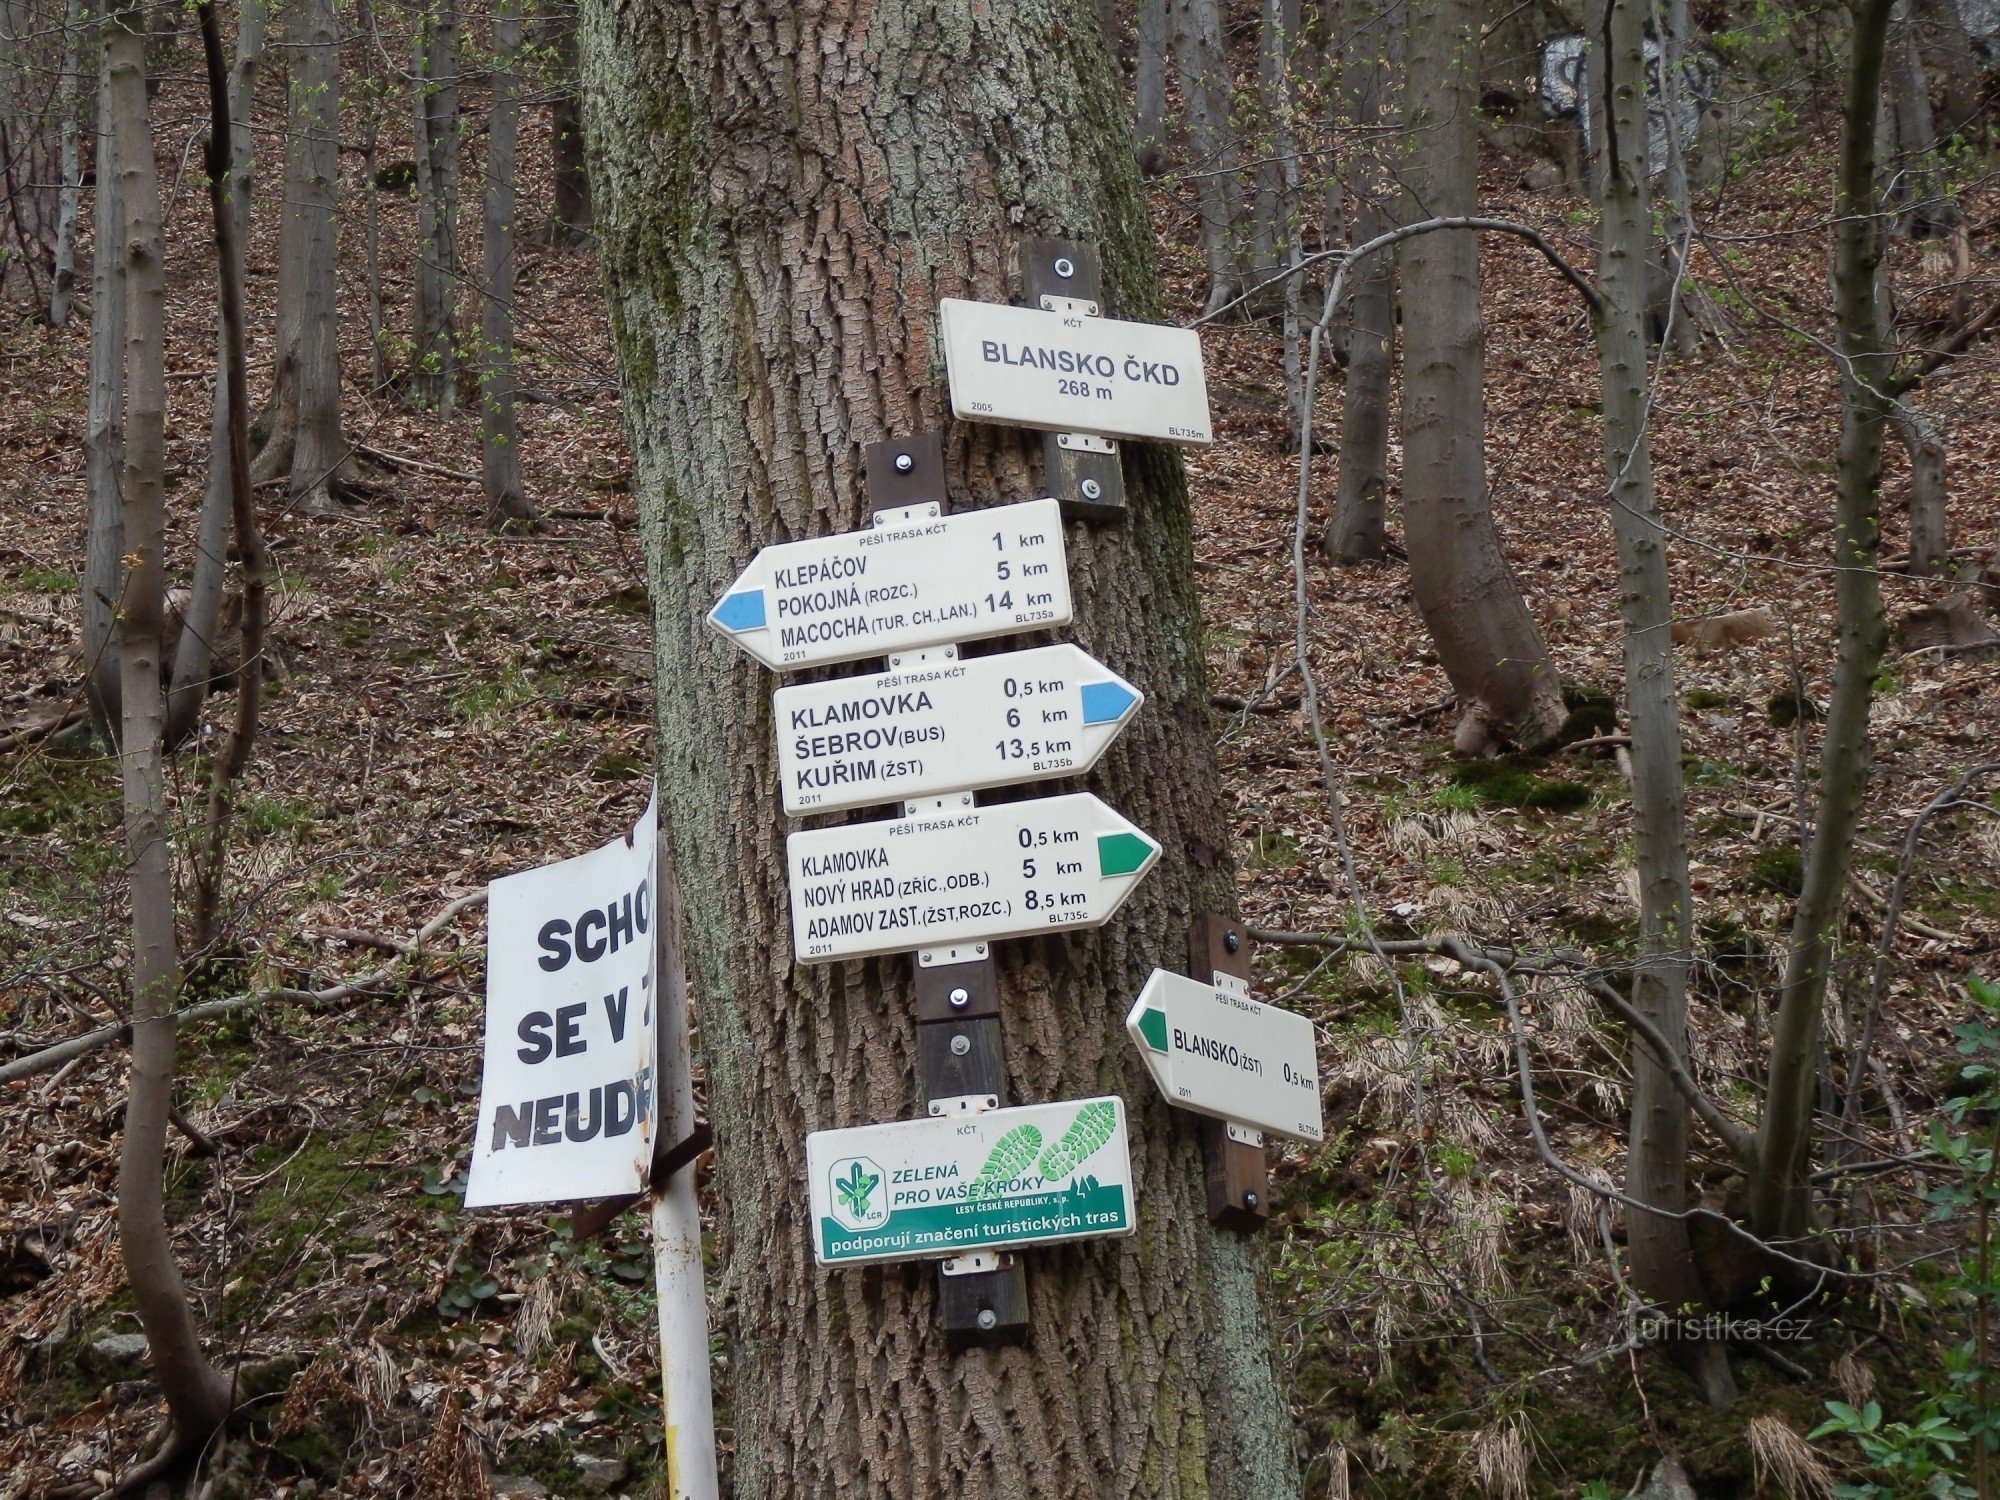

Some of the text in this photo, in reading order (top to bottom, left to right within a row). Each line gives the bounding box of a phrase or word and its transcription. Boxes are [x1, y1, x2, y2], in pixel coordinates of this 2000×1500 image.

[1063, 318, 1082, 329] KČT
[982, 341, 1180, 386] BLANSKO ČKD
[1058, 379, 1113, 400] 268 m
[971, 402, 993, 413] 2005
[1169, 427, 1204, 440] BL735m
[859, 523, 947, 547] PĚŠÍ TRASA KČT
[775, 532, 1045, 589] KLEPÁČOV 1 km
[778, 560, 1048, 618] POKOJNÁ (ROZC.) 5 km
[781, 615, 869, 648] MACOCHA
[984, 590, 1014, 614] 14
[1027, 591, 1052, 607] km
[1015, 611, 1054, 624] BL735a
[783, 650, 806, 661] 2011
[877, 667, 967, 689] PĚŠÍ TRASA KČT
[791, 677, 1064, 730] KLAMOVKA 0,5 km
[1006, 708, 1020, 729] 6
[1043, 708, 1068, 723] km
[797, 738, 1071, 790] KUŘIM (ŽST) 13,5 km
[1033, 757, 1073, 771] BL735b
[799, 794, 822, 805] 2011
[889, 815, 980, 837] PĚŠÍ TRASA KČT
[801, 828, 1079, 878] KLAMOVKA 0,5 km
[804, 878, 846, 908] NOVÝ
[851, 877, 894, 902] HRAD
[1022, 858, 1036, 878] 5
[1056, 861, 1082, 875] km
[807, 911, 874, 940] ADAMOV
[1025, 890, 1054, 911] 8,5
[1060, 892, 1086, 906] km
[1049, 911, 1088, 923] BL735c
[809, 944, 832, 955] 2011
[1229, 998, 1249, 1013] TRASA
[517, 1001, 587, 1065] SE
[603, 985, 629, 1044] V
[1283, 1062, 1298, 1087] 0,5
[1301, 1074, 1314, 1091] km
[1179, 1086, 1192, 1099] 2011
[956, 1124, 977, 1136] KČT
[892, 1161, 959, 1184] ZELENÁ
[894, 1176, 1045, 1205] PRO VAŠE KROKY
[955, 1204, 975, 1215] LESY
[831, 1211, 1119, 1255] podporují značení turistických tras
